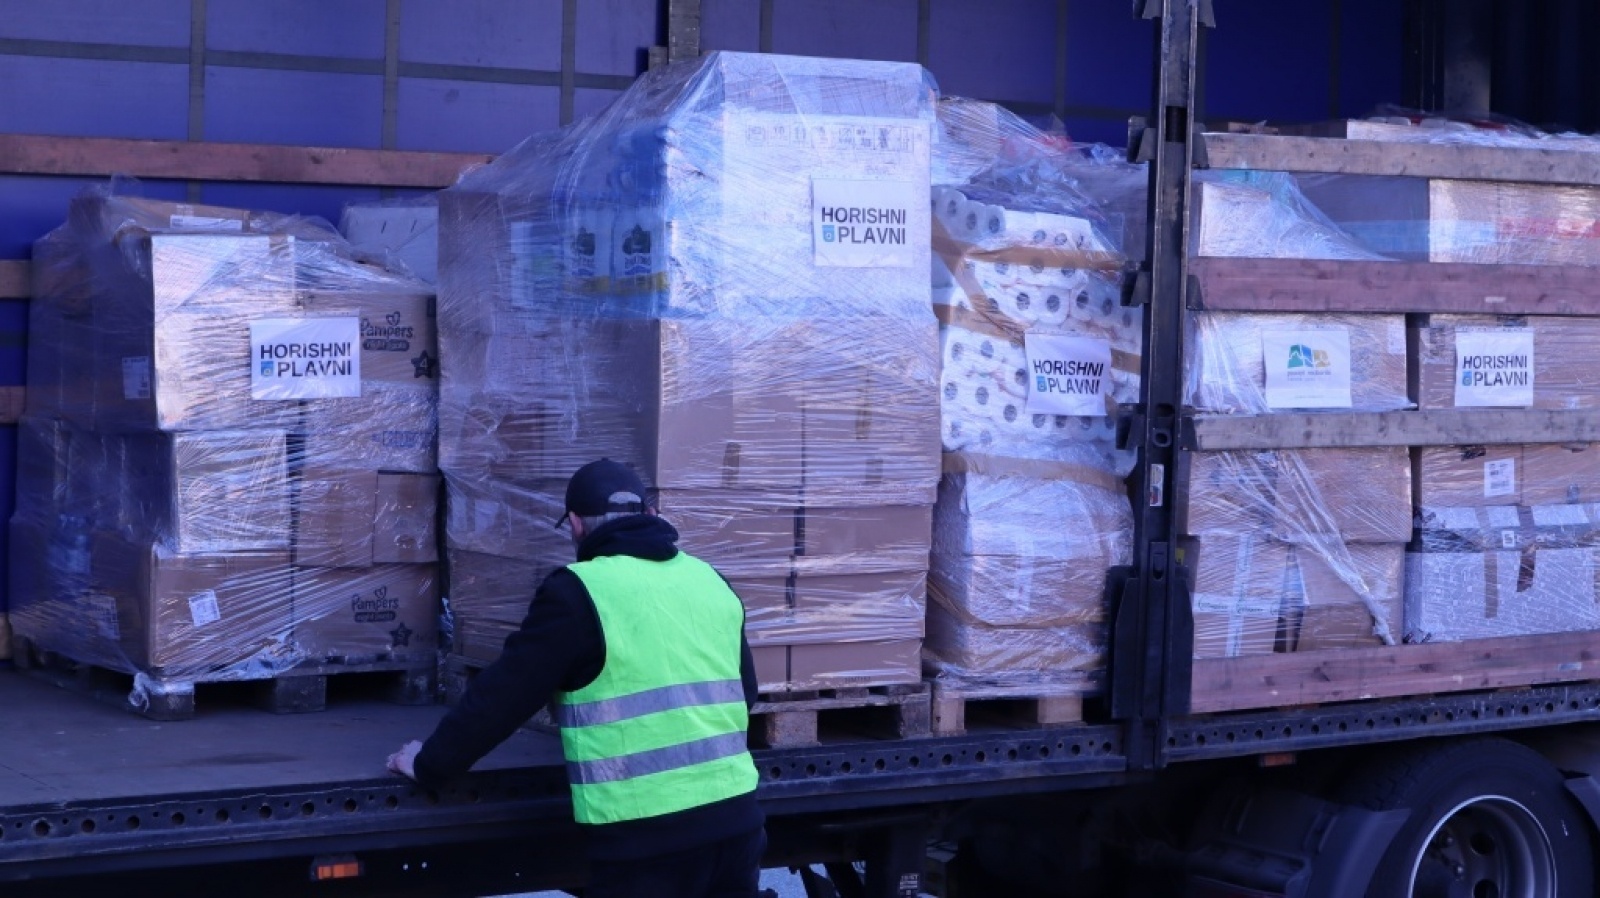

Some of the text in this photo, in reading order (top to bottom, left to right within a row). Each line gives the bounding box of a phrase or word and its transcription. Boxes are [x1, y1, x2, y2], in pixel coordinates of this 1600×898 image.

[821, 207, 907, 225] HORISHNI
[838, 226, 907, 245] PLAVNI
[360, 318, 414, 340] Pampers
[260, 342, 351, 359] HORISHNI
[277, 359, 352, 378] PLAVNI
[1033, 359, 1104, 376] HORISHNI
[1461, 354, 1528, 369] HORISHNI
[1047, 377, 1100, 395] PLAVNI
[1473, 371, 1528, 387] PLAVNI
[351, 593, 400, 611] Pampers
